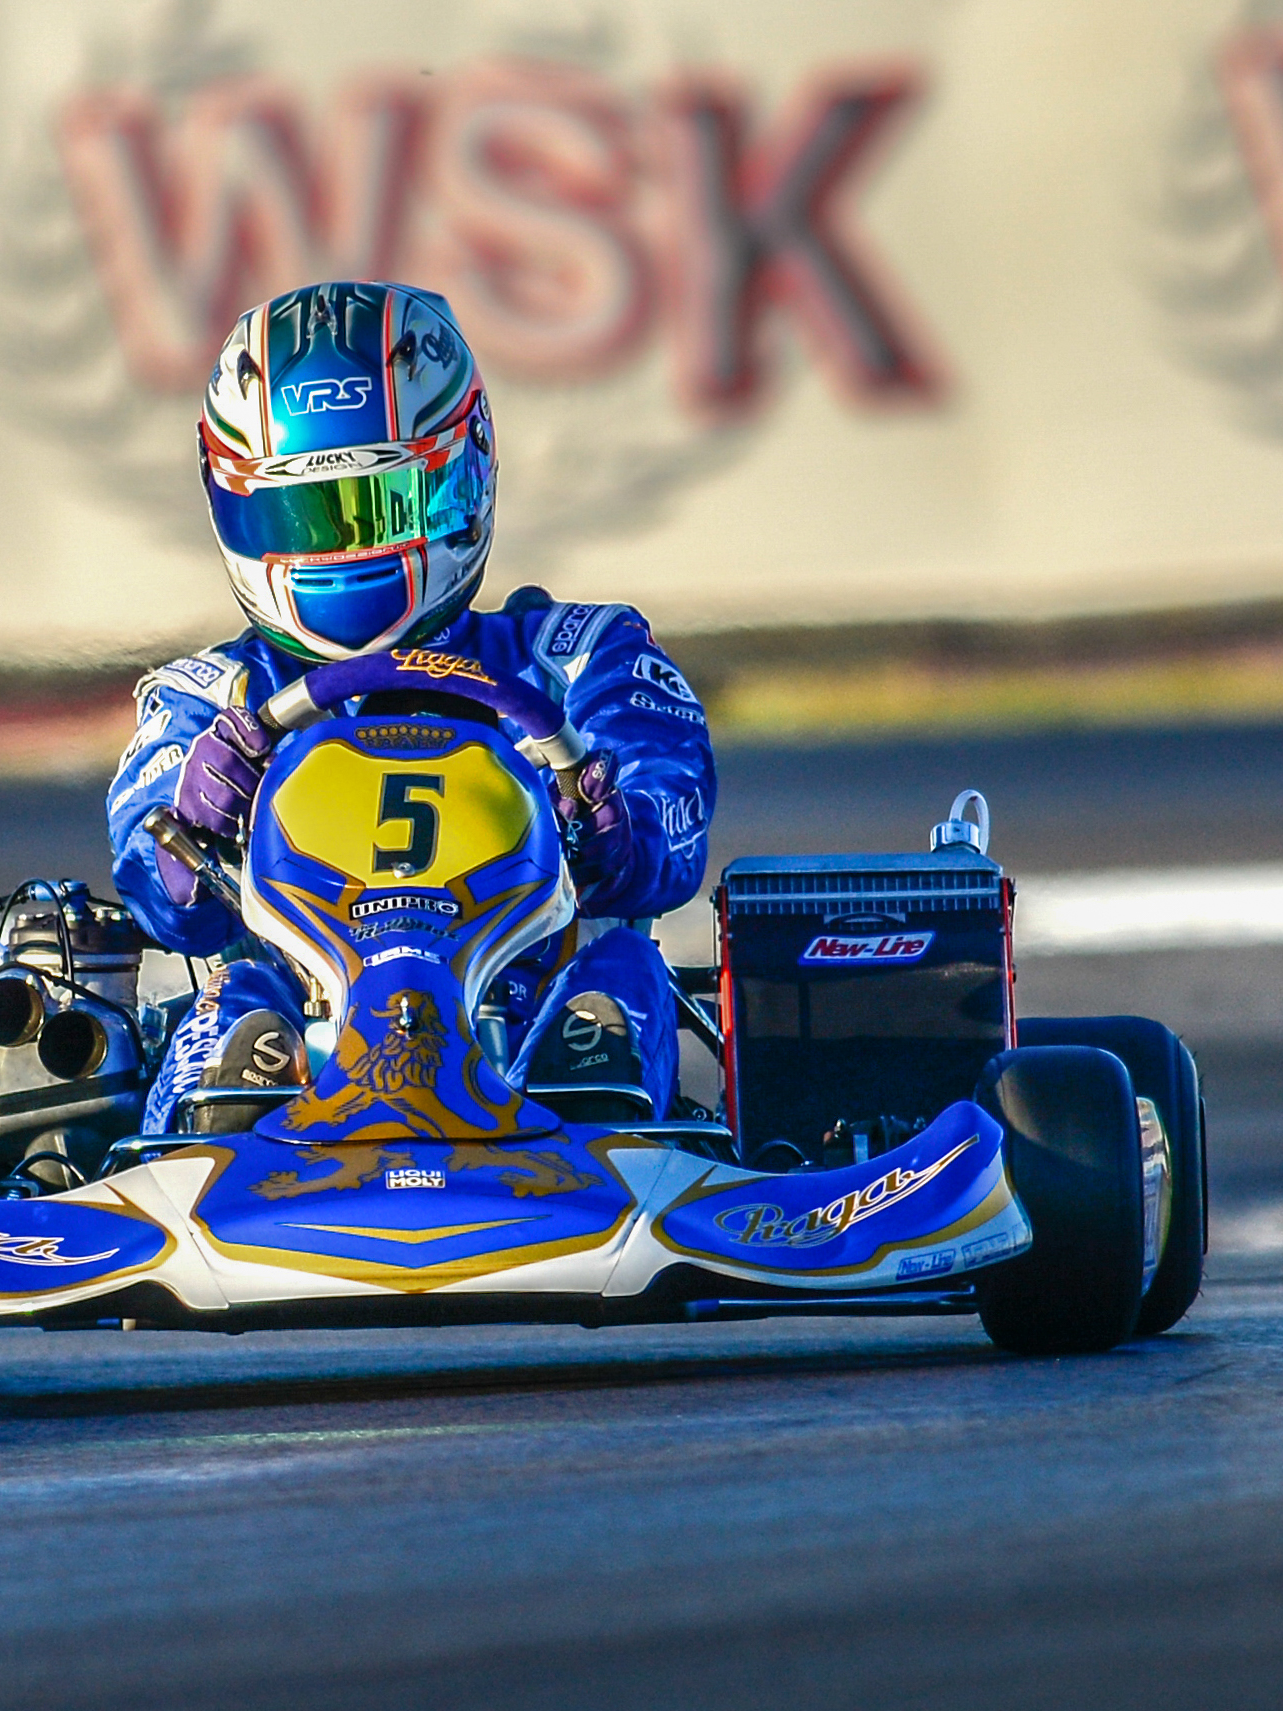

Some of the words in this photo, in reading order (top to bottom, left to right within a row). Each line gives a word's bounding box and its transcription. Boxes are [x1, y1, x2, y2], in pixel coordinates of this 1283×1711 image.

[59, 58, 965, 424] WSK
[281, 376, 373, 416] VRS
[305, 450, 358, 468] LUCKY
[551, 604, 597, 654] sparc
[372, 772, 445, 876] 5
[352, 895, 460, 918] UNIPRO
[807, 935, 925, 957] New-Line
[389, 1169, 441, 1178] LIQUI
[389, 1177, 443, 1187] MOLY
[713, 1133, 980, 1249] Praga
